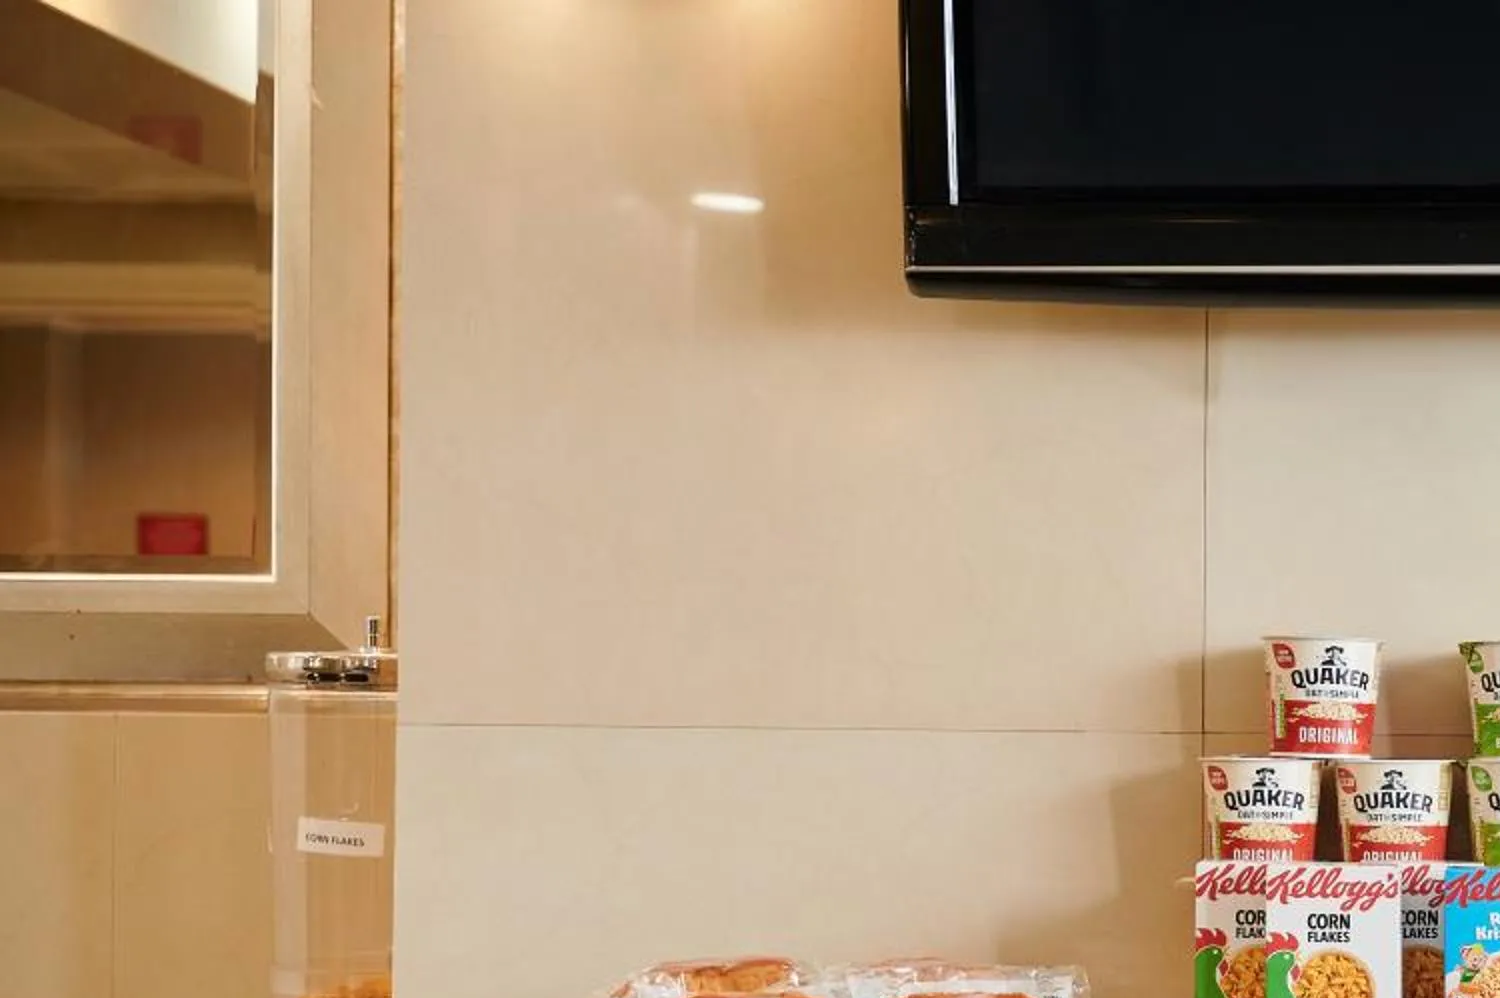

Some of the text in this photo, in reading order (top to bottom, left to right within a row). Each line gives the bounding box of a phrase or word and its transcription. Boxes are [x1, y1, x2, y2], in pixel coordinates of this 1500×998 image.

[1291, 667, 1369, 690] QUAKER
[1299, 727, 1358, 744] ORIGINAL
[1223, 789, 1305, 811] QUAKER
[1353, 792, 1433, 813] QUAKER
[1265, 866, 1399, 912] Kellogg's
[1236, 910, 1267, 925] COR
[1307, 913, 1351, 929] CORN
[1236, 928, 1267, 938] FLAK
[1307, 931, 1351, 943] FLAKES
[1402, 928, 1439, 938] LAKES
